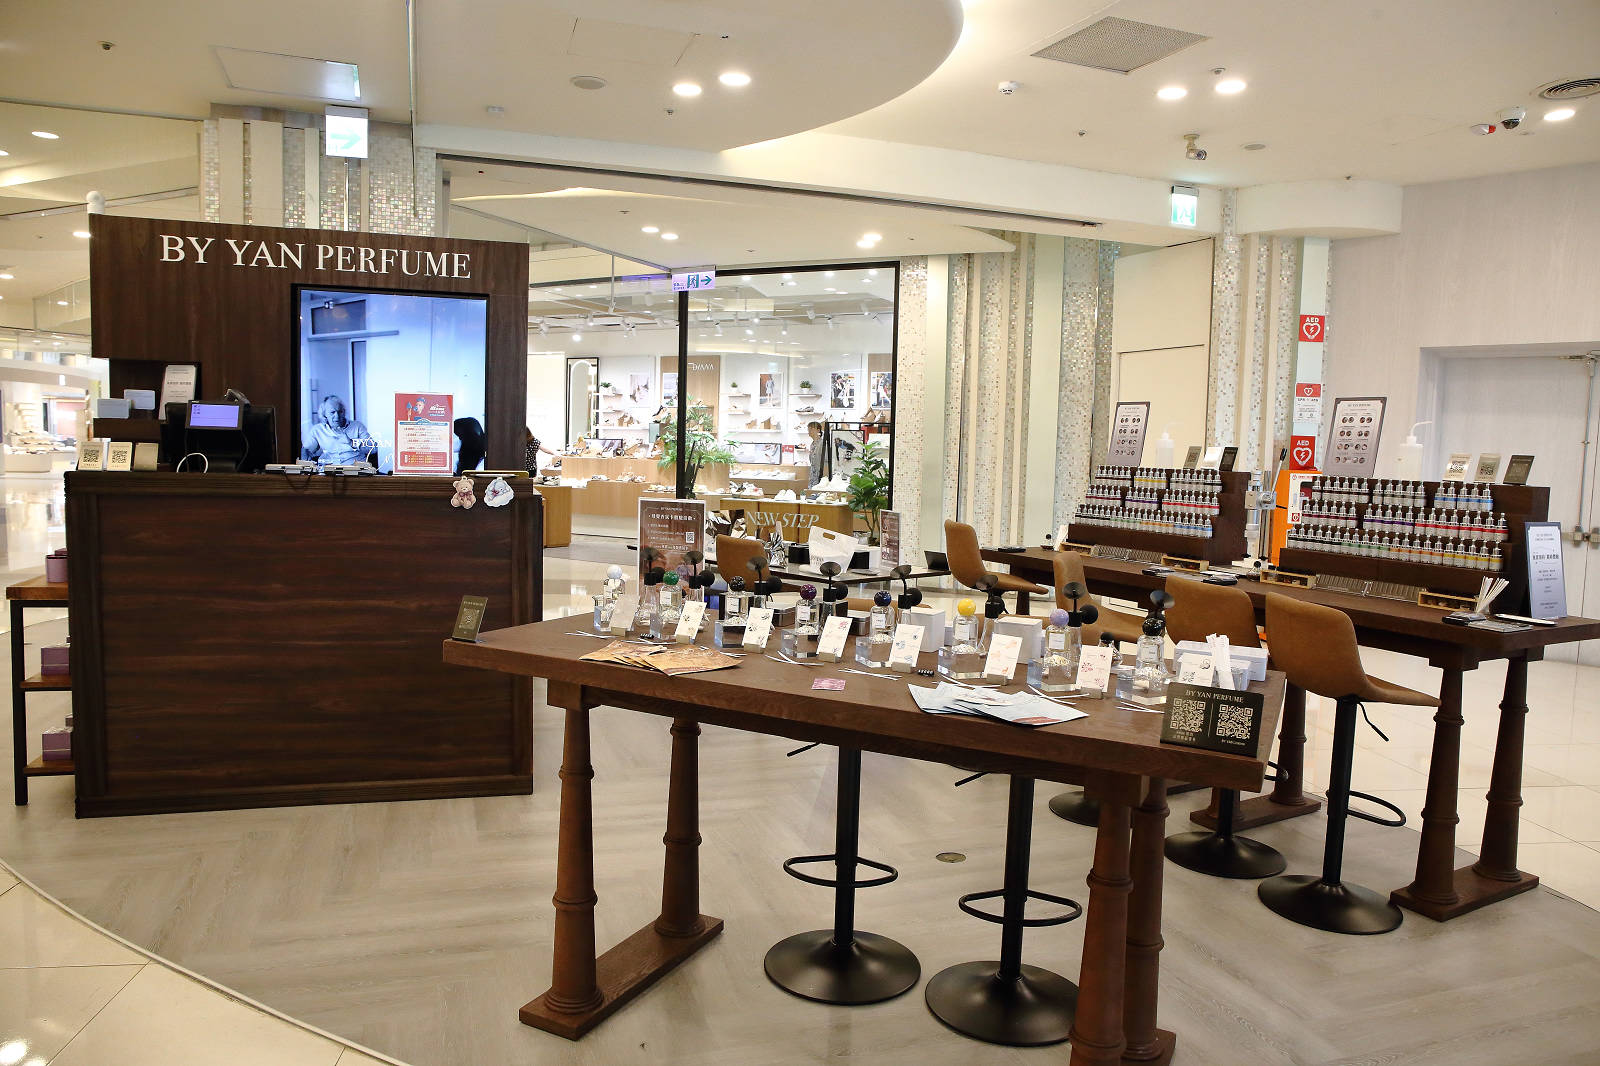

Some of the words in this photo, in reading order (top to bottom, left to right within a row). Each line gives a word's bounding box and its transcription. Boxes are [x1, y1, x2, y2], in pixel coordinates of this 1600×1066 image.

[160, 234, 216, 264] BY
[225, 238, 306, 270] YAN
[315, 244, 471, 279] PERFUME
[746, 511, 780, 526] NEW
[782, 513, 819, 528] STEP
[1185, 689, 1197, 697] BY
[1213, 693, 1244, 703] PERFUME
